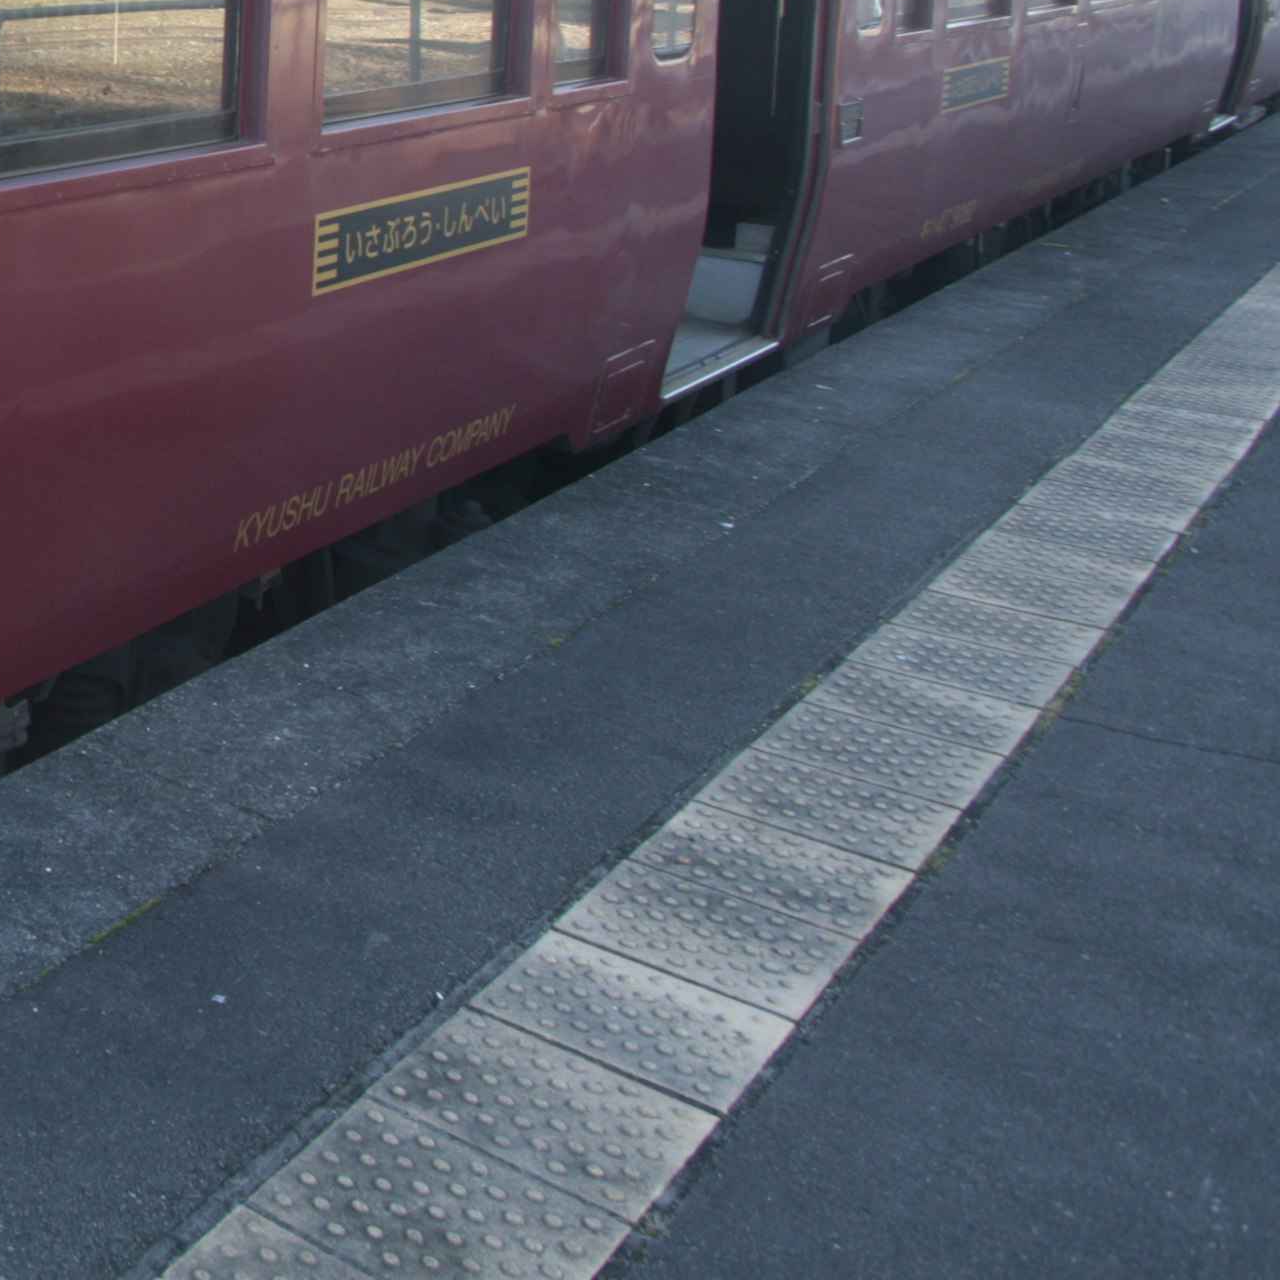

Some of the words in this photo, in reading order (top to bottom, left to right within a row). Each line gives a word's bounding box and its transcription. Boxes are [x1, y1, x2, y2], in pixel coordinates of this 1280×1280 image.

[233, 481, 333, 553] KYUSHU
[335, 442, 426, 509] RAILWAY
[427, 403, 517, 468] COMPANY
